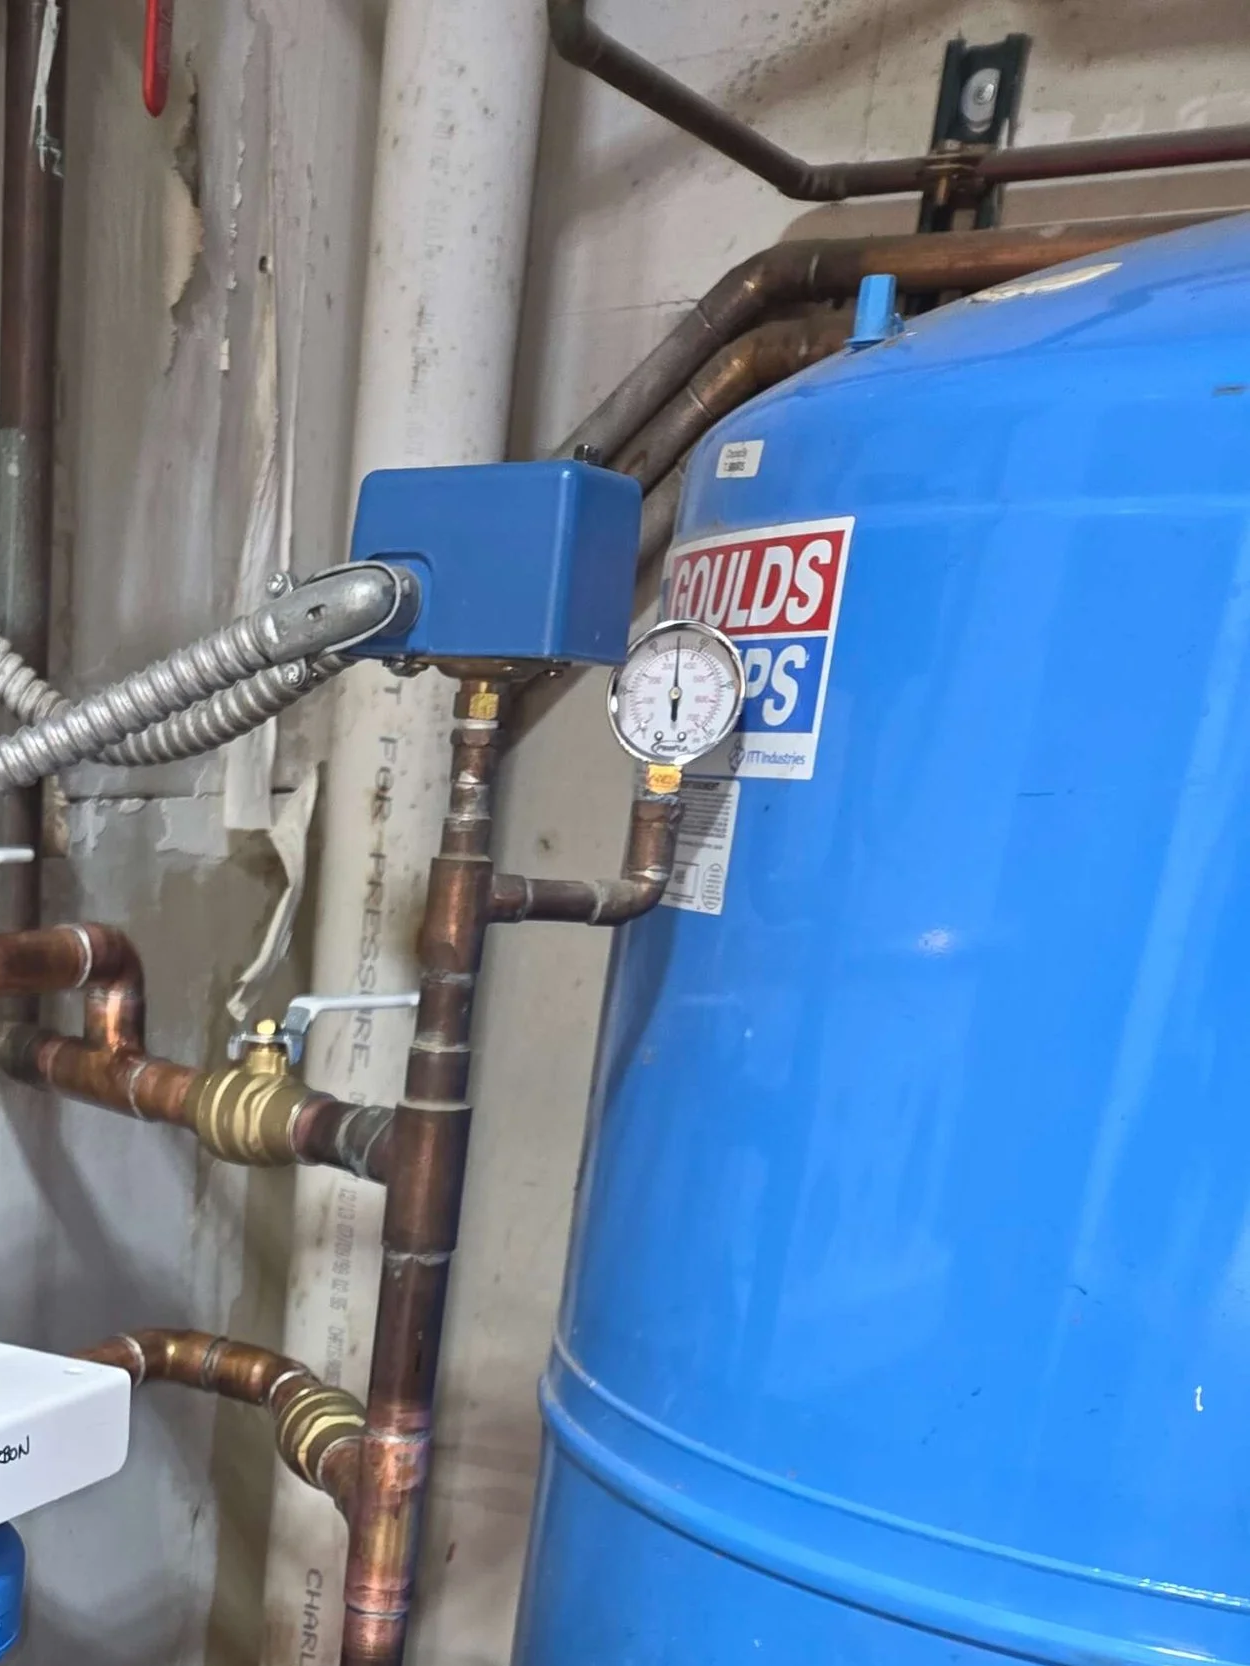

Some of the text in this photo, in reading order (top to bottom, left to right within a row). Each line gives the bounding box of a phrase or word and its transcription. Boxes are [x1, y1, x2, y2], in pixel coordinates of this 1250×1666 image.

[670, 538, 833, 629] GOULDS
[370, 735, 398, 825] FOR
[350, 852, 387, 1074] PRESSRE
